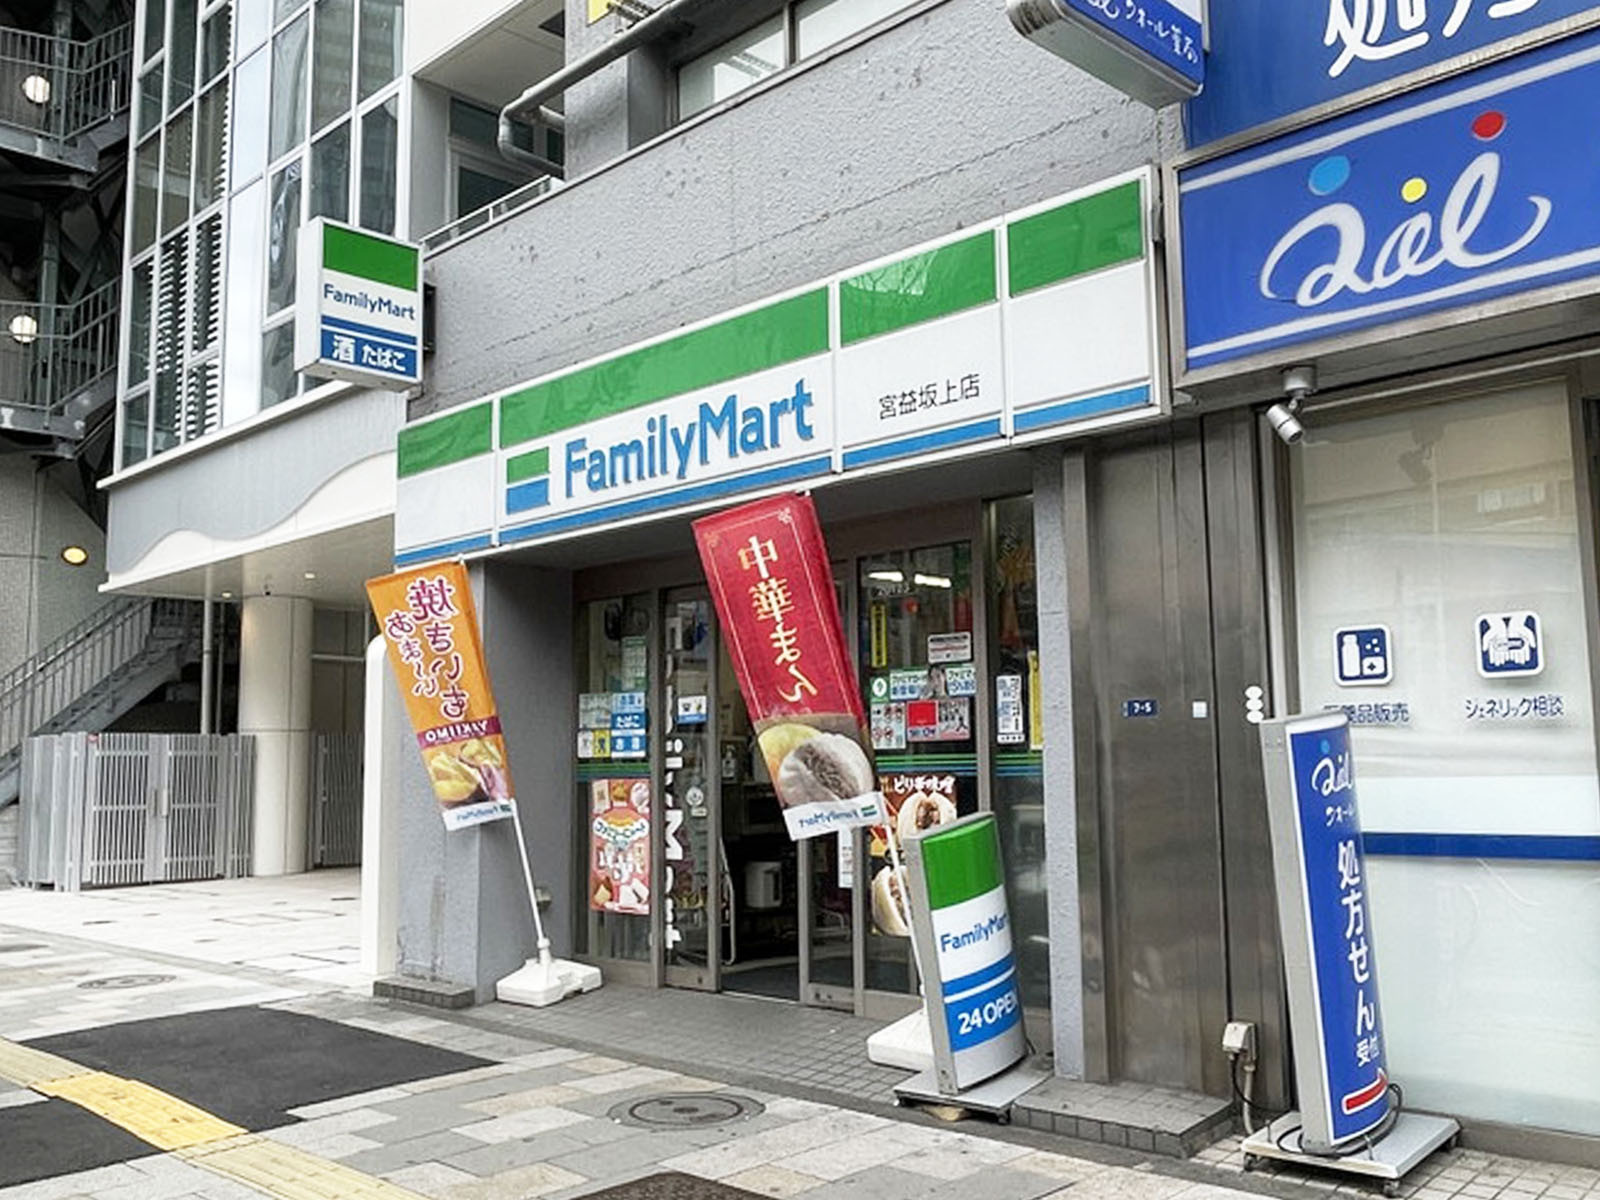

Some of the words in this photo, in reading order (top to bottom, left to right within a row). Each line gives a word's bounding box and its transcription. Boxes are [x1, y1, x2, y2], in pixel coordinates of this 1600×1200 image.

[323, 282, 416, 321] FamilyMart
[332, 334, 356, 364] 酒
[361, 344, 407, 372] たばこ
[879, 373, 980, 420] 宮益坂上店
[565, 378, 815, 499] FamilyMart
[737, 535, 818, 703] 中華まん
[941, 912, 1008, 953] FamilyMar
[1338, 839, 1375, 1036] 処方せん
